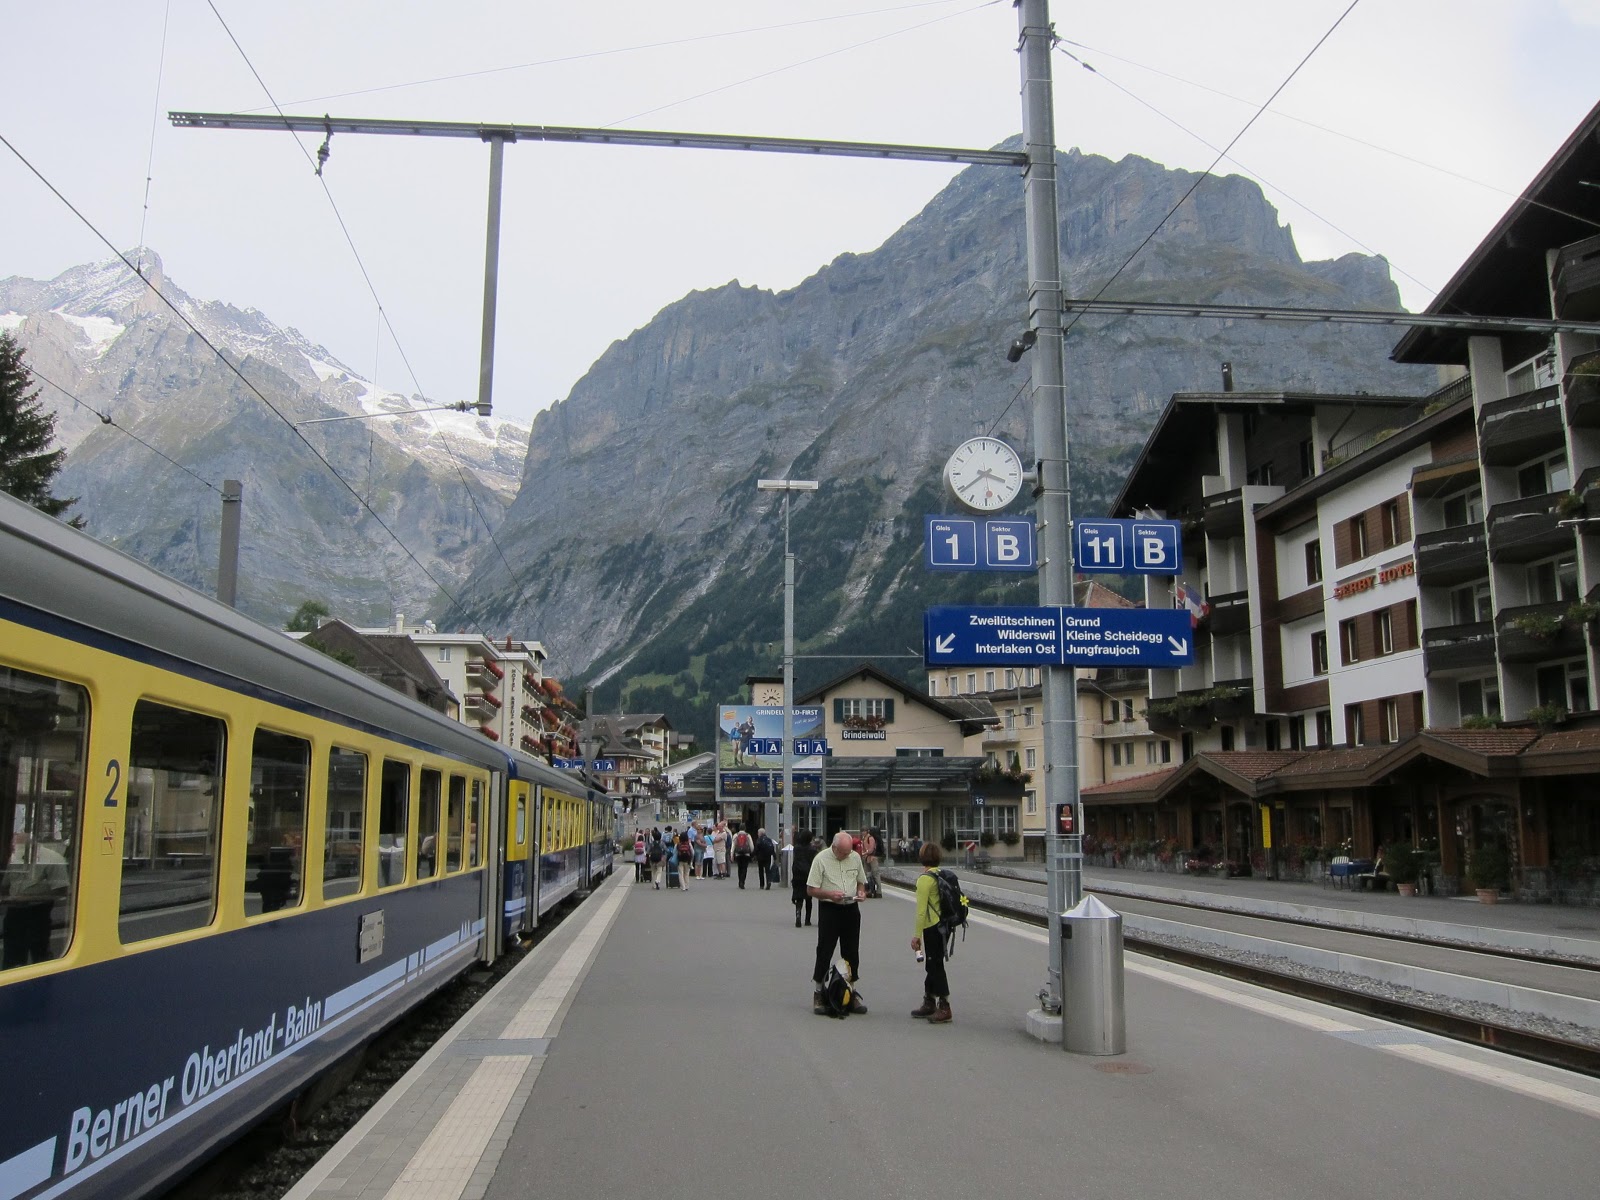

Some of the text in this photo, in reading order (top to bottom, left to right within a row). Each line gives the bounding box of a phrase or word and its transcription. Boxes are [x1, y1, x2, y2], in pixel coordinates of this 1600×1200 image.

[945, 533, 959, 560] 1
[997, 534, 1020, 561] B
[1087, 536, 1116, 563] 11
[1143, 537, 1166, 564] B
[1333, 561, 1414, 601] DERBY HOTE
[969, 615, 1055, 626] Zweilütschinen
[1065, 616, 1101, 627] Grund
[997, 629, 1056, 640] Wilderswil
[1066, 630, 1163, 644] Kleine Scheidegg
[975, 643, 1056, 654] Interlaken Ost
[1066, 644, 1140, 657] Jungfraujoch
[843, 730, 885, 739] Grindelwald
[769, 743, 778, 753] A
[797, 743, 807, 753] 11
[815, 743, 824, 753] A
[104, 758, 121, 807] 2
[63, 1075, 175, 1175] Berner
